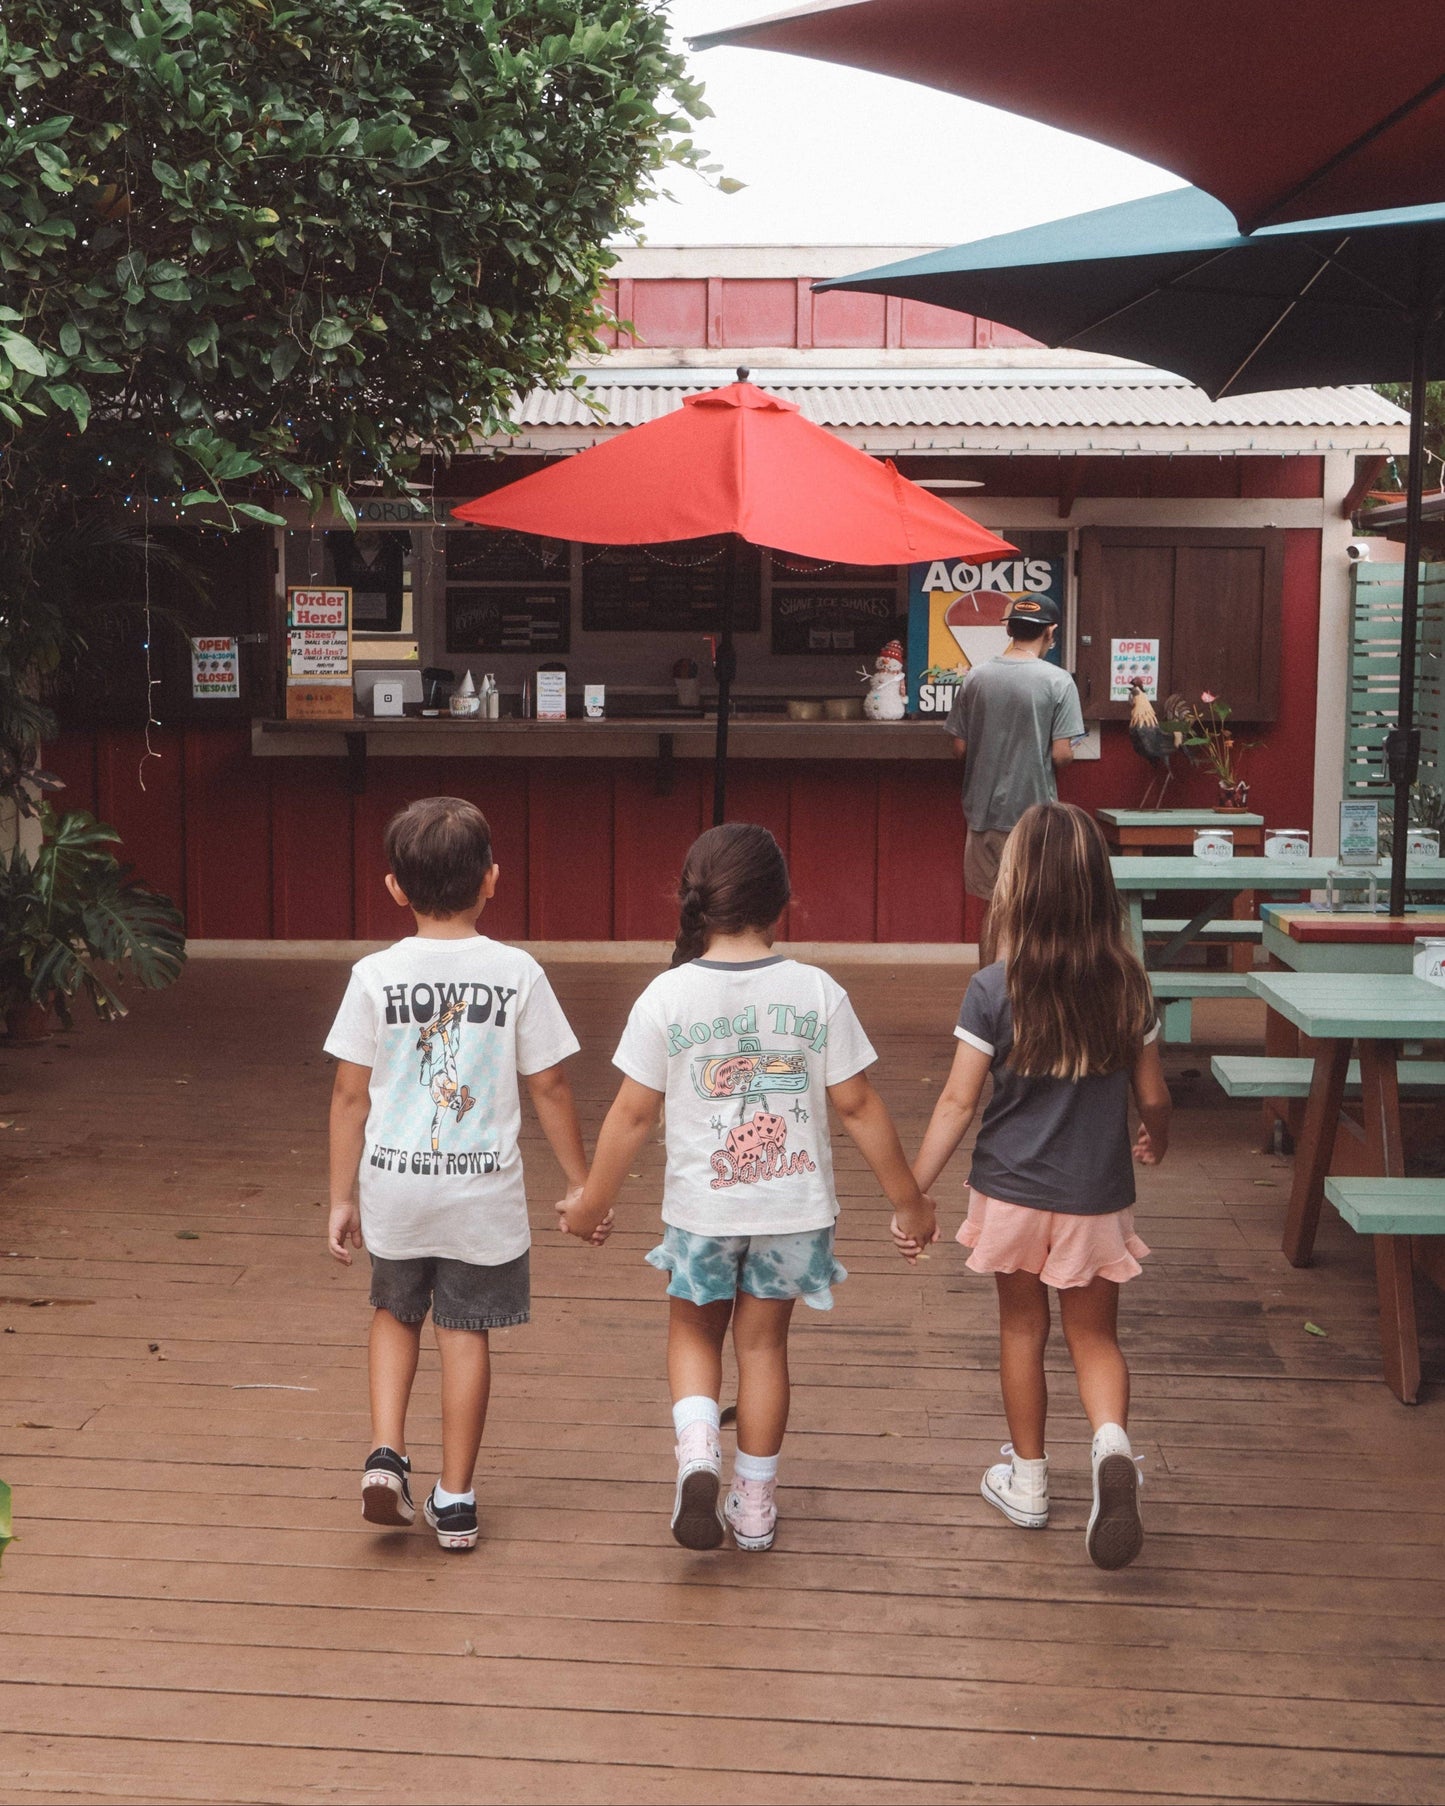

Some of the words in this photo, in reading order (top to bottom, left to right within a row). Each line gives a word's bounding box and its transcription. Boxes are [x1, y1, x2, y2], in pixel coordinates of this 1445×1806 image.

[921, 557, 1053, 593] AOKI'S
[295, 591, 344, 606] Order
[779, 598, 812, 616] SHAVE
[815, 598, 839, 608] ICE
[840, 598, 890, 618] SHAKES
[296, 610, 343, 624] Here!
[291, 632, 302, 640] #1
[304, 630, 337, 639] Sizes?
[198, 639, 231, 651] OPEN
[291, 648, 303, 656] #2
[304, 647, 344, 656] Add-Ins?
[1118, 641, 1152, 654] OPEN
[196, 672, 235, 683] CLOSED
[1114, 675, 1153, 685] CLOED
[194, 684, 237, 693] TUESDAYS
[1112, 687, 1156, 695] TUEYS
[919, 684, 961, 712] SH
[383, 983, 518, 1027] HOWDY
[667, 1004, 759, 1057] Road
[370, 1144, 408, 1173] LET'S
[411, 1151, 443, 1175] GET
[446, 1151, 500, 1175] ROWDY
[710, 1141, 816, 1190] Darlin
